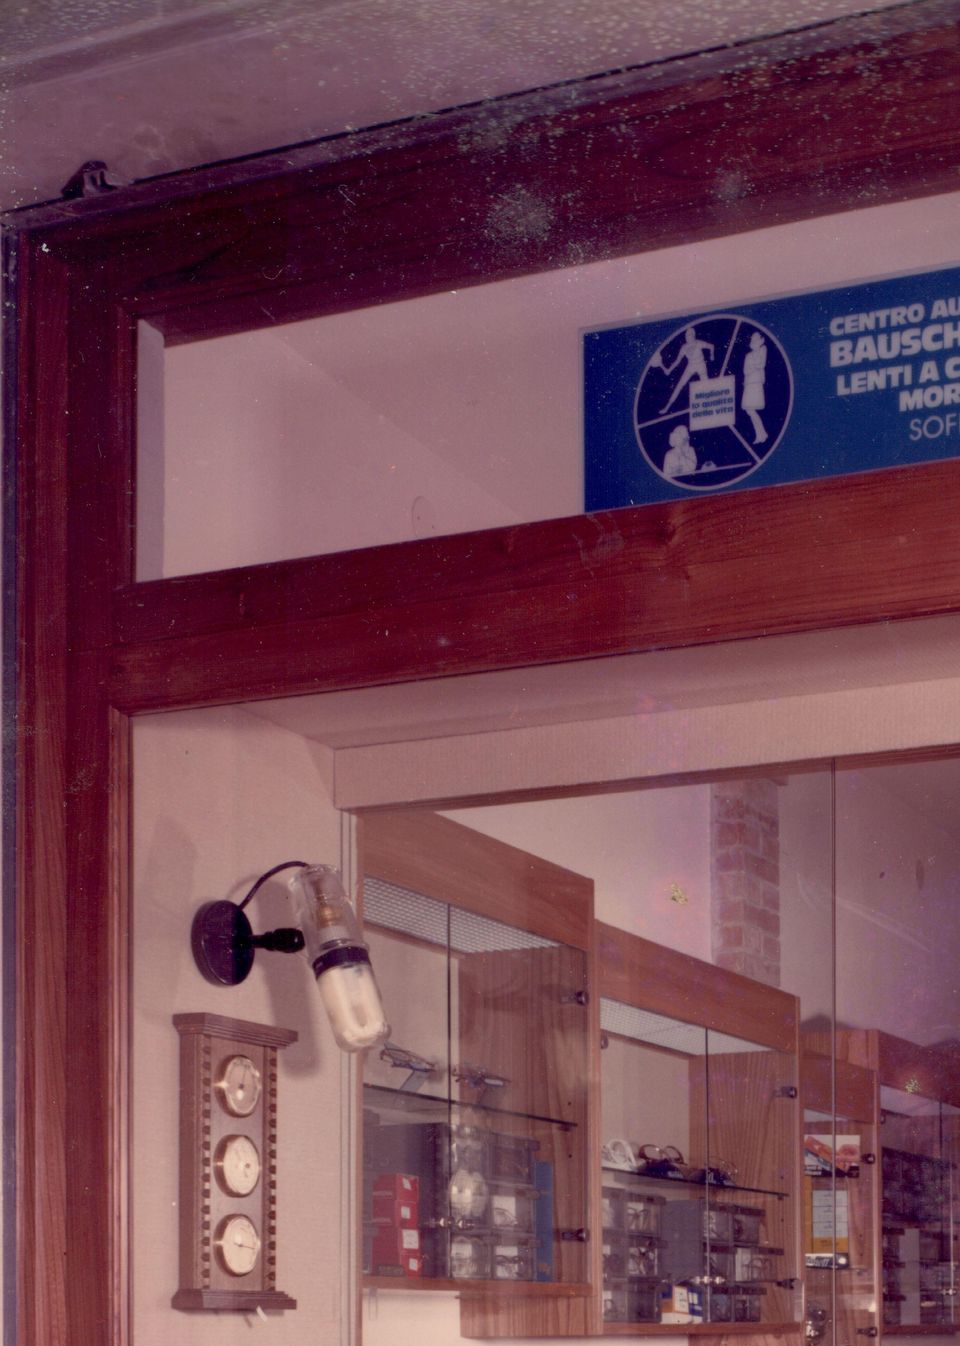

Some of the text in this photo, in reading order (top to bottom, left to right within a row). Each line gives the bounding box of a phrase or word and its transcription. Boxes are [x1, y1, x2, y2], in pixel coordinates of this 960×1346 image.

[829, 303, 925, 337] CENTRO
[836, 364, 912, 396] LENTI
[918, 360, 940, 383] A
